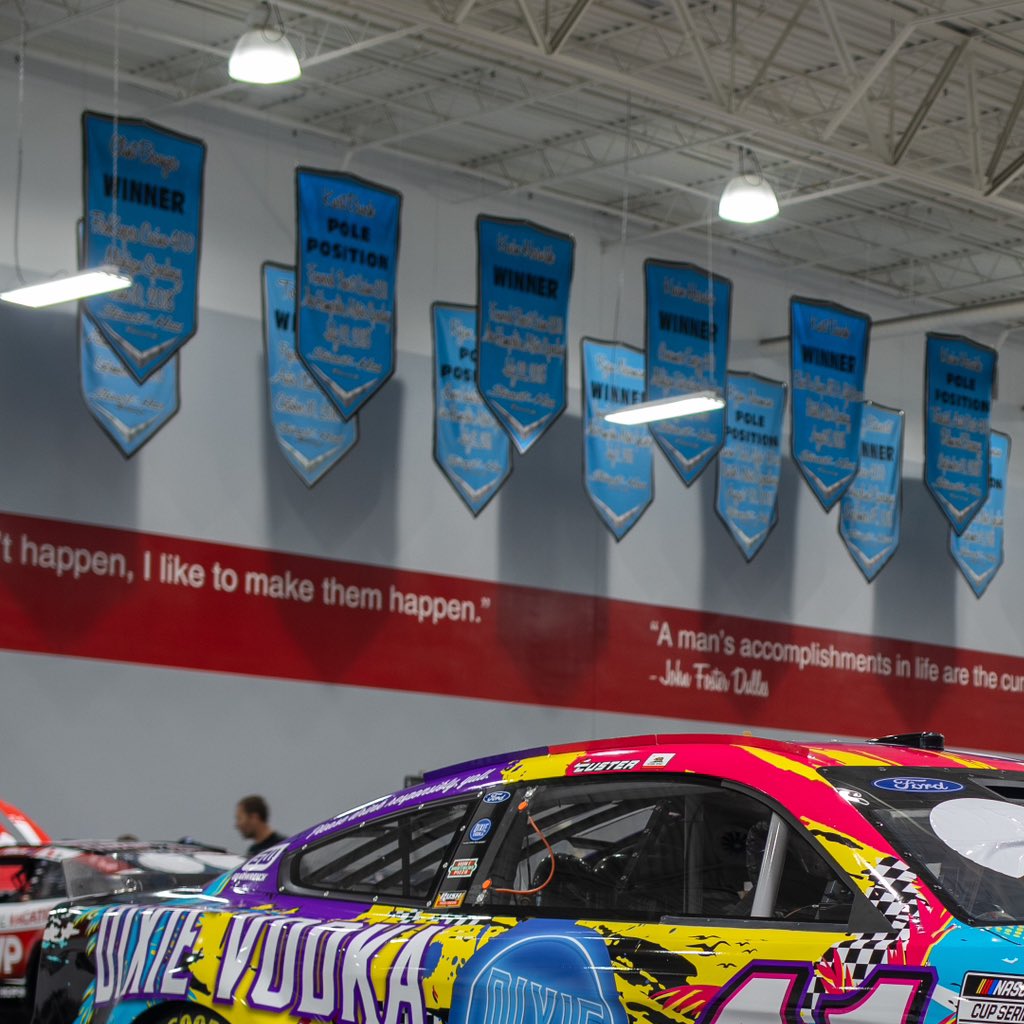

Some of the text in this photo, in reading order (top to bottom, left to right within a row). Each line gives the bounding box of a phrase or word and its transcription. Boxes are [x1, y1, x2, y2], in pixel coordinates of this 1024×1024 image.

[104, 173, 186, 215] WINNER
[327, 218, 371, 242] POLE
[307, 238, 390, 270] POSITION
[493, 266, 560, 299] WINNER
[659, 310, 719, 343] WINNER
[802, 346, 857, 374] WINNER
[21, 534, 134, 584] happen,
[143, 551, 151, 581] I
[160, 553, 205, 588] like
[212, 561, 238, 593] to
[245, 571, 315, 602] make
[322, 577, 382, 611] them
[678, 630, 734, 656] man's
[740, 638, 892, 675] accomplishments
[896, 654, 911, 678] in
[915, 655, 939, 682] life
[943, 666, 969, 687] are
[973, 665, 997, 689] the
[573, 759, 641, 774] CUSTER
[487, 791, 506, 802] Ford
[893, 778, 949, 791] Ford
[971, 1003, 996, 1020] CUP
